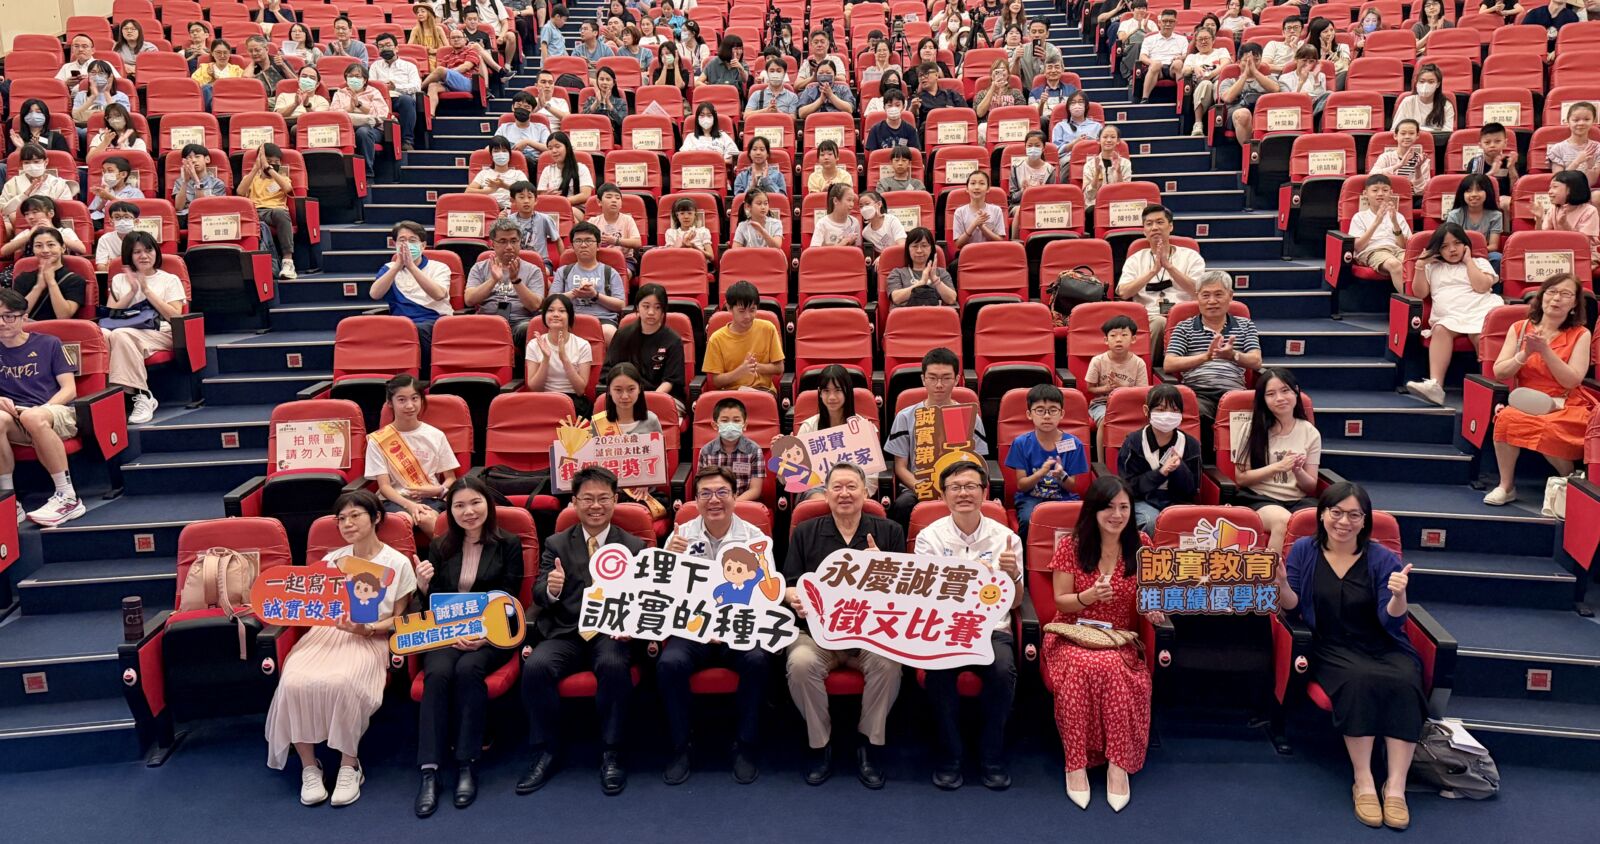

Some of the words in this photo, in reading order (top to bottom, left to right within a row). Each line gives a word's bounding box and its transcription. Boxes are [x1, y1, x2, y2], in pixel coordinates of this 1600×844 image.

[573, 274, 600, 286] Bear
[293, 433, 335, 446] 拍照區
[595, 436, 638, 446] 2026永慶
[595, 445, 651, 457] 誠實徵文比賽
[808, 431, 845, 455] 誠實
[286, 446, 342, 460] 請勿入座
[818, 447, 874, 474] 小作家
[914, 407, 935, 500] 誠實第一名
[635, 550, 710, 593] 埋下
[1140, 549, 1275, 582] 誠實教育
[266, 574, 345, 594] 一起寫下
[820, 553, 979, 603] 永慶誠實
[263, 599, 344, 619] 誠實故事
[436, 600, 480, 619] 誠實是
[1140, 586, 1278, 611] 推廣績優學校
[582, 590, 793, 648] 誠實的種子
[828, 598, 987, 648] 徵文比賽
[397, 620, 483, 649] 開啟信任之鑰
